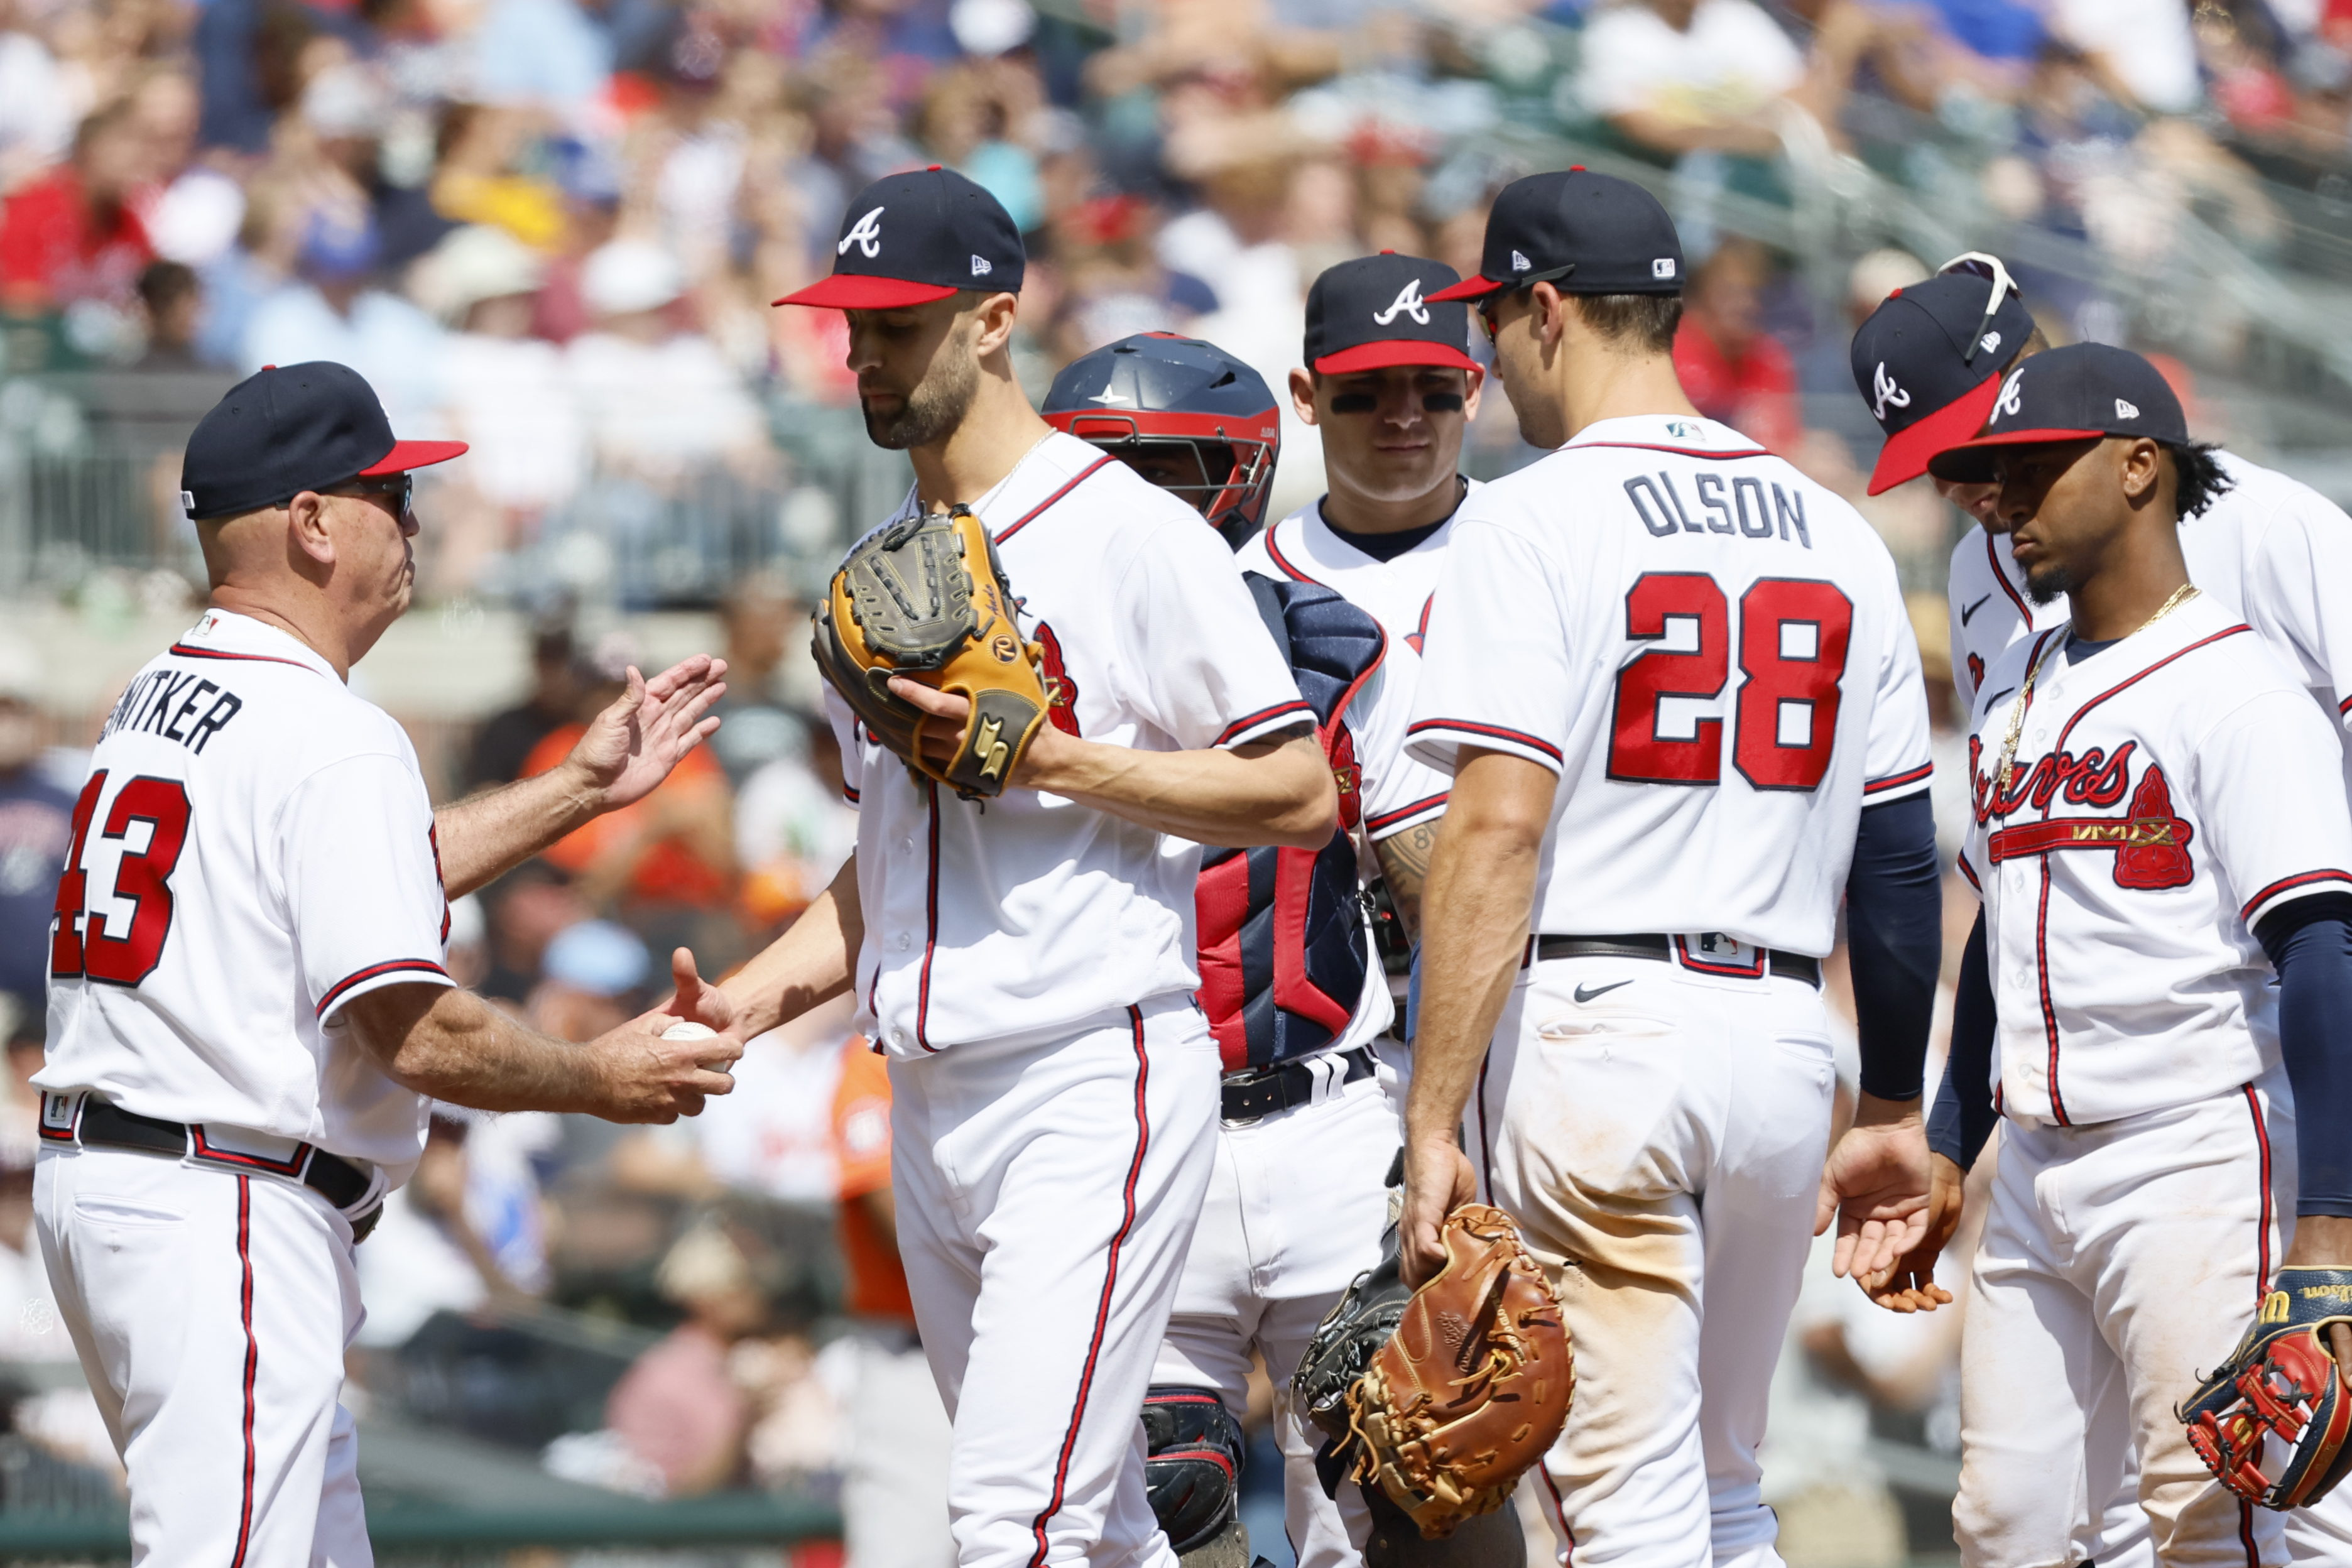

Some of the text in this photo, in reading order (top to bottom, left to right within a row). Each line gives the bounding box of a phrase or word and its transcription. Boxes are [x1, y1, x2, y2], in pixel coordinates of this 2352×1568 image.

[1373, 278, 1430, 325] A
[1623, 471, 1812, 550] OLSON
[1606, 570, 1854, 793] 28
[51, 768, 192, 988] 43
